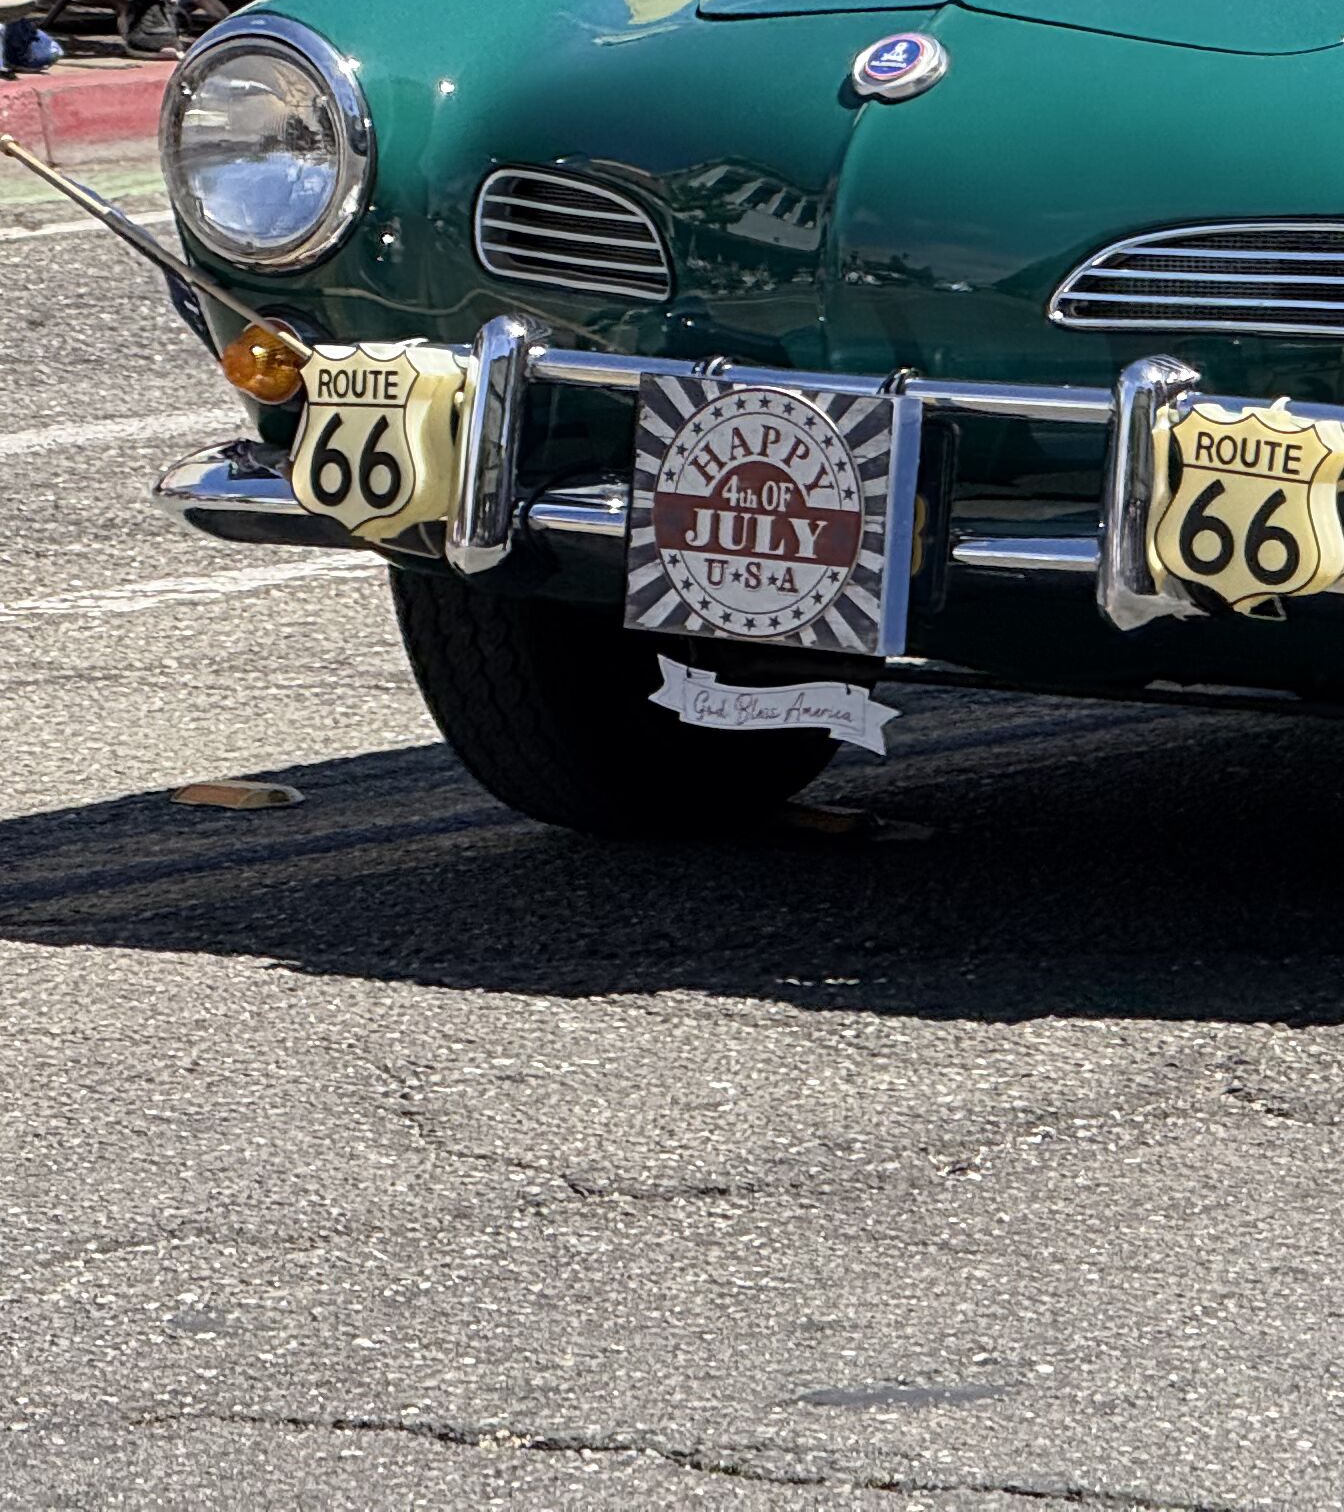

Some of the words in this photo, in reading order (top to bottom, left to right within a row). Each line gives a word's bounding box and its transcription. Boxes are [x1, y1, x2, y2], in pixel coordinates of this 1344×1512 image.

[317, 369, 399, 400] ROUTE
[310, 412, 402, 509] 66
[688, 424, 835, 496] HAPPY
[1195, 431, 1303, 475] ROUTE
[722, 475, 758, 509] 4th
[761, 480, 795, 512] OF
[685, 508, 828, 560] JULY
[1179, 479, 1300, 586] 66
[693, 690, 726, 721] God
[734, 693, 781, 726] Bless
[784, 691, 852, 723] America
